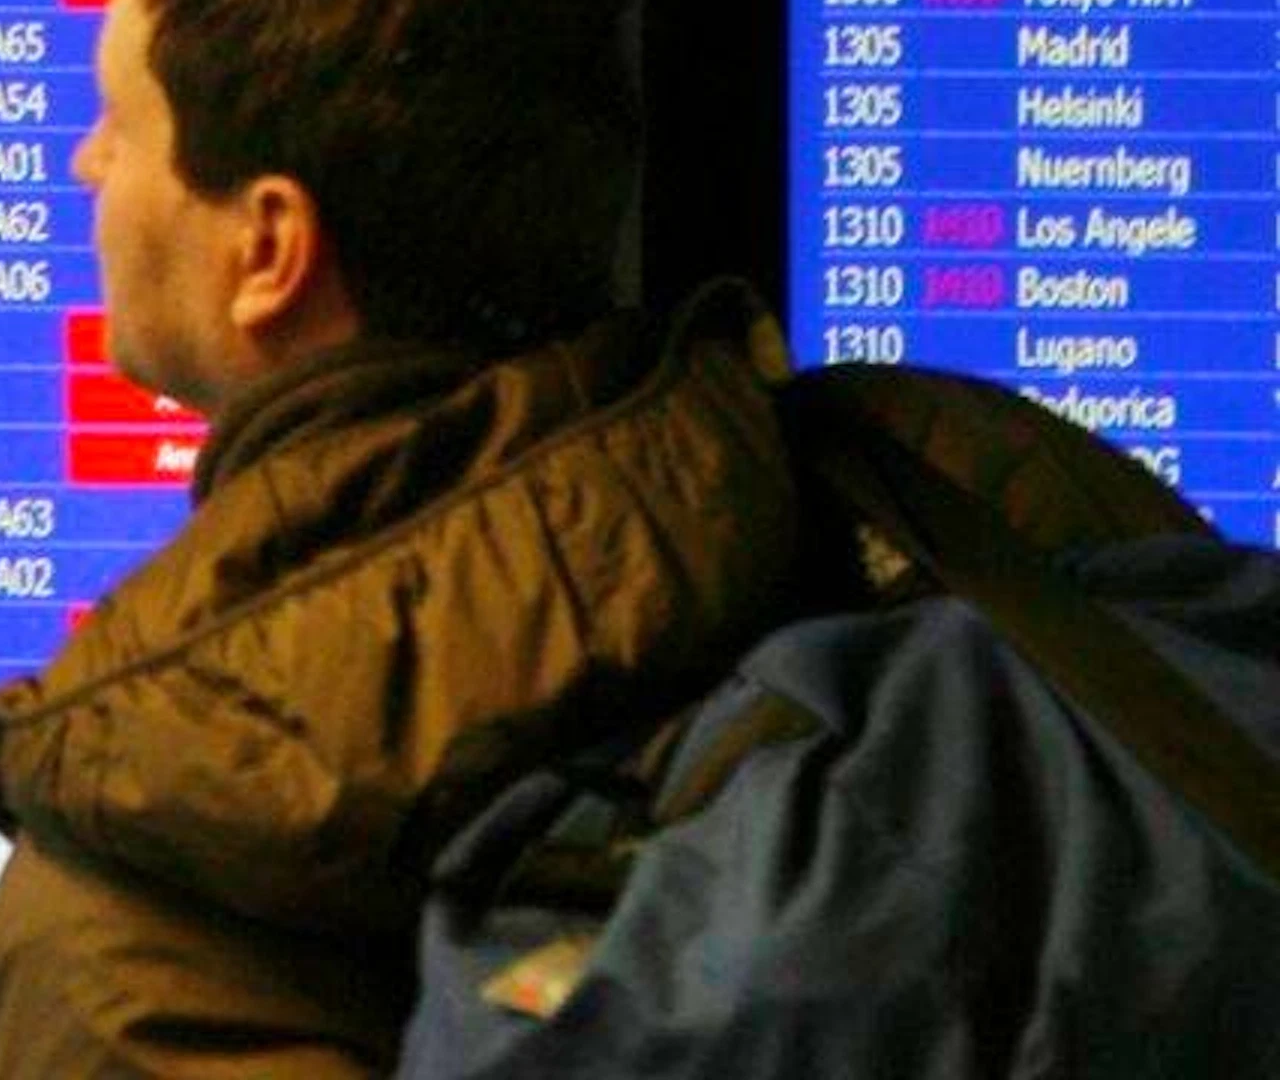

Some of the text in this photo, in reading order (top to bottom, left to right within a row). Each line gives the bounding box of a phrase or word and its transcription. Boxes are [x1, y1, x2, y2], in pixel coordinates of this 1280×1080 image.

[826, 86, 1142, 127] 1305 Helsinki
[825, 207, 903, 246] 1310
[1018, 207, 1075, 247] Los
[1085, 209, 1198, 257] Angele
[825, 267, 903, 306] 1310
[1018, 267, 1128, 308] Boston
